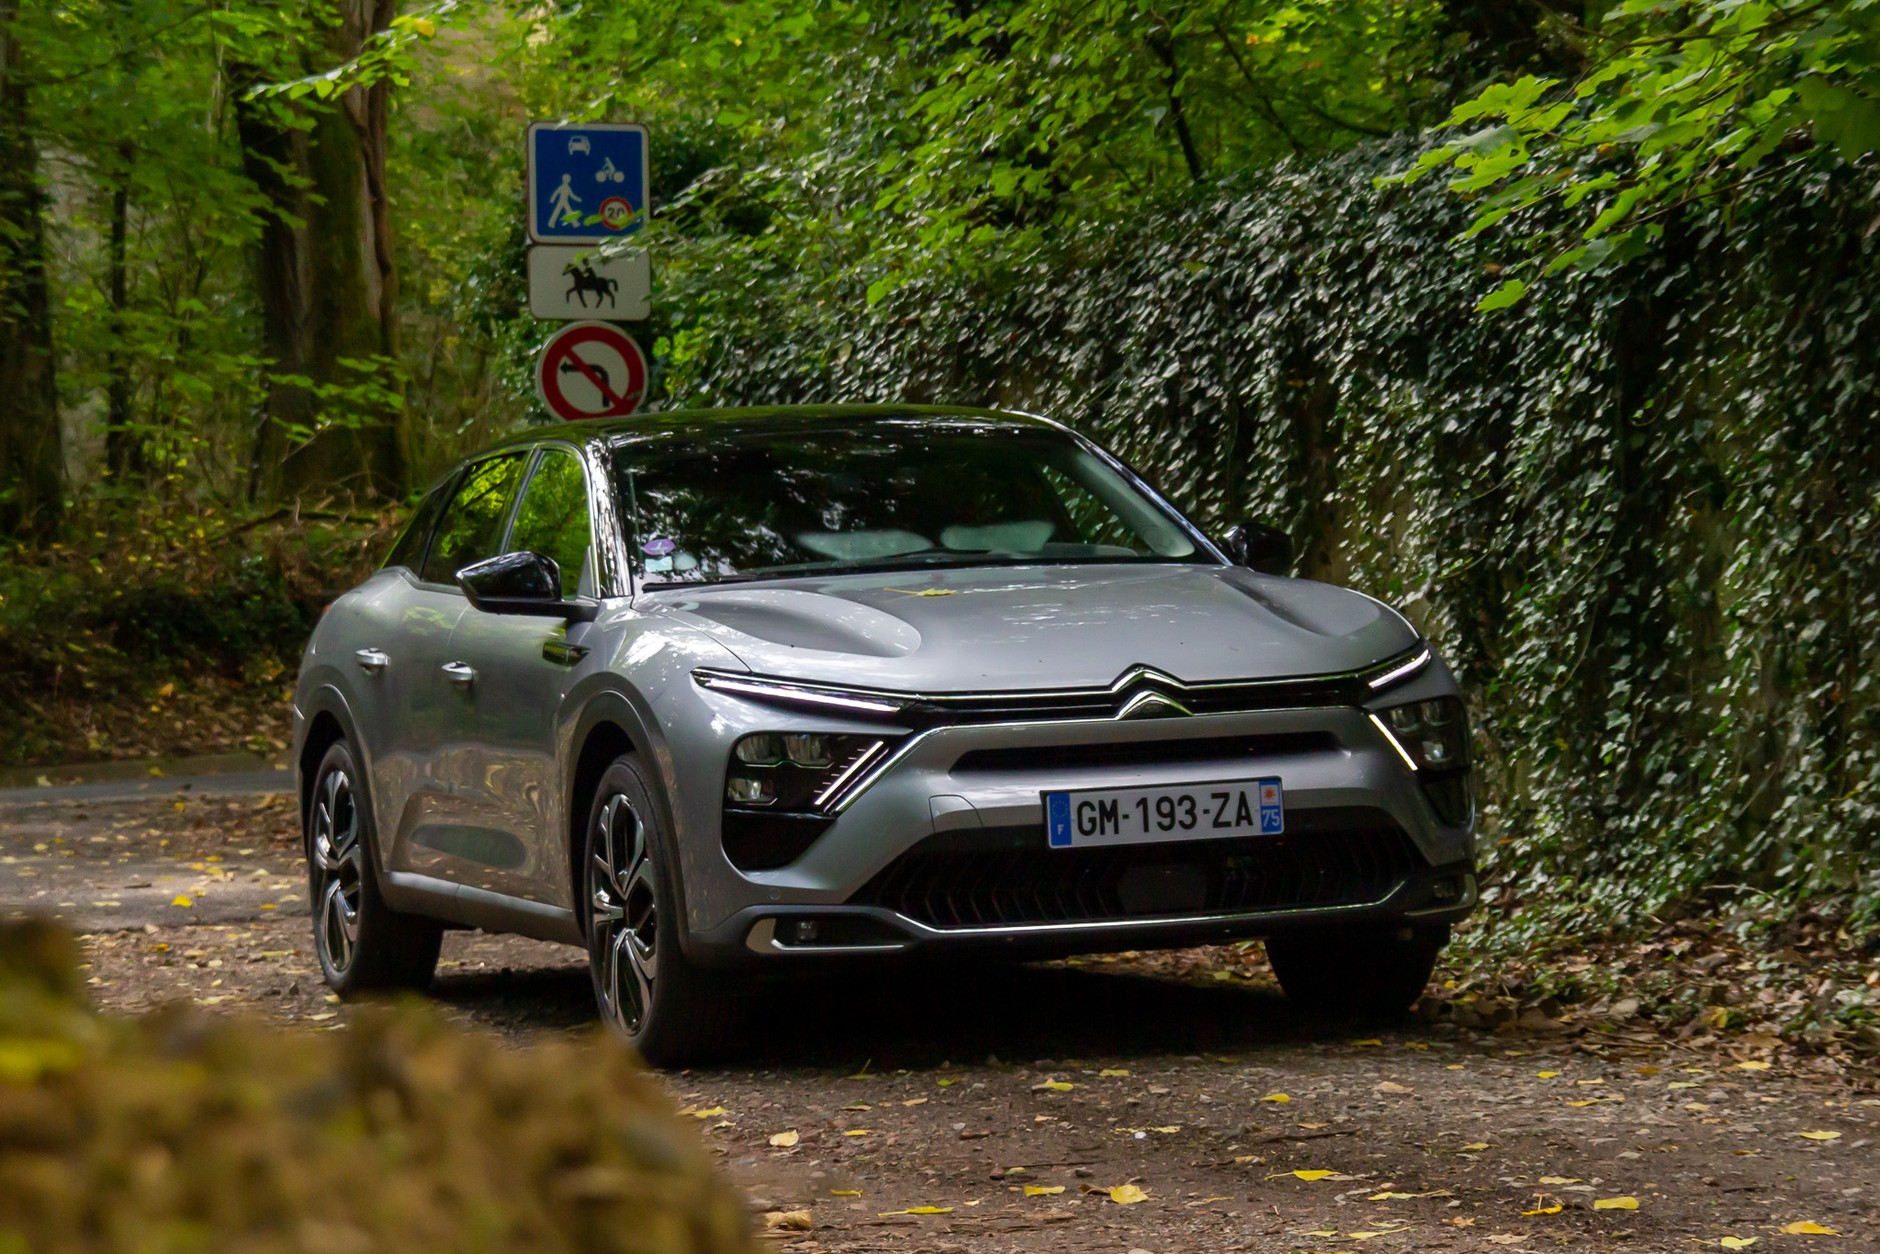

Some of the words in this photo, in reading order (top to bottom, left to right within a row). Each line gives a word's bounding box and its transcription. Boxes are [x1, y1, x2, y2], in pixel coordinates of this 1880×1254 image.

[1076, 791, 1254, 837] GM-193-ZA
[1262, 809, 1280, 828] 75
[1057, 823, 1065, 835] F
